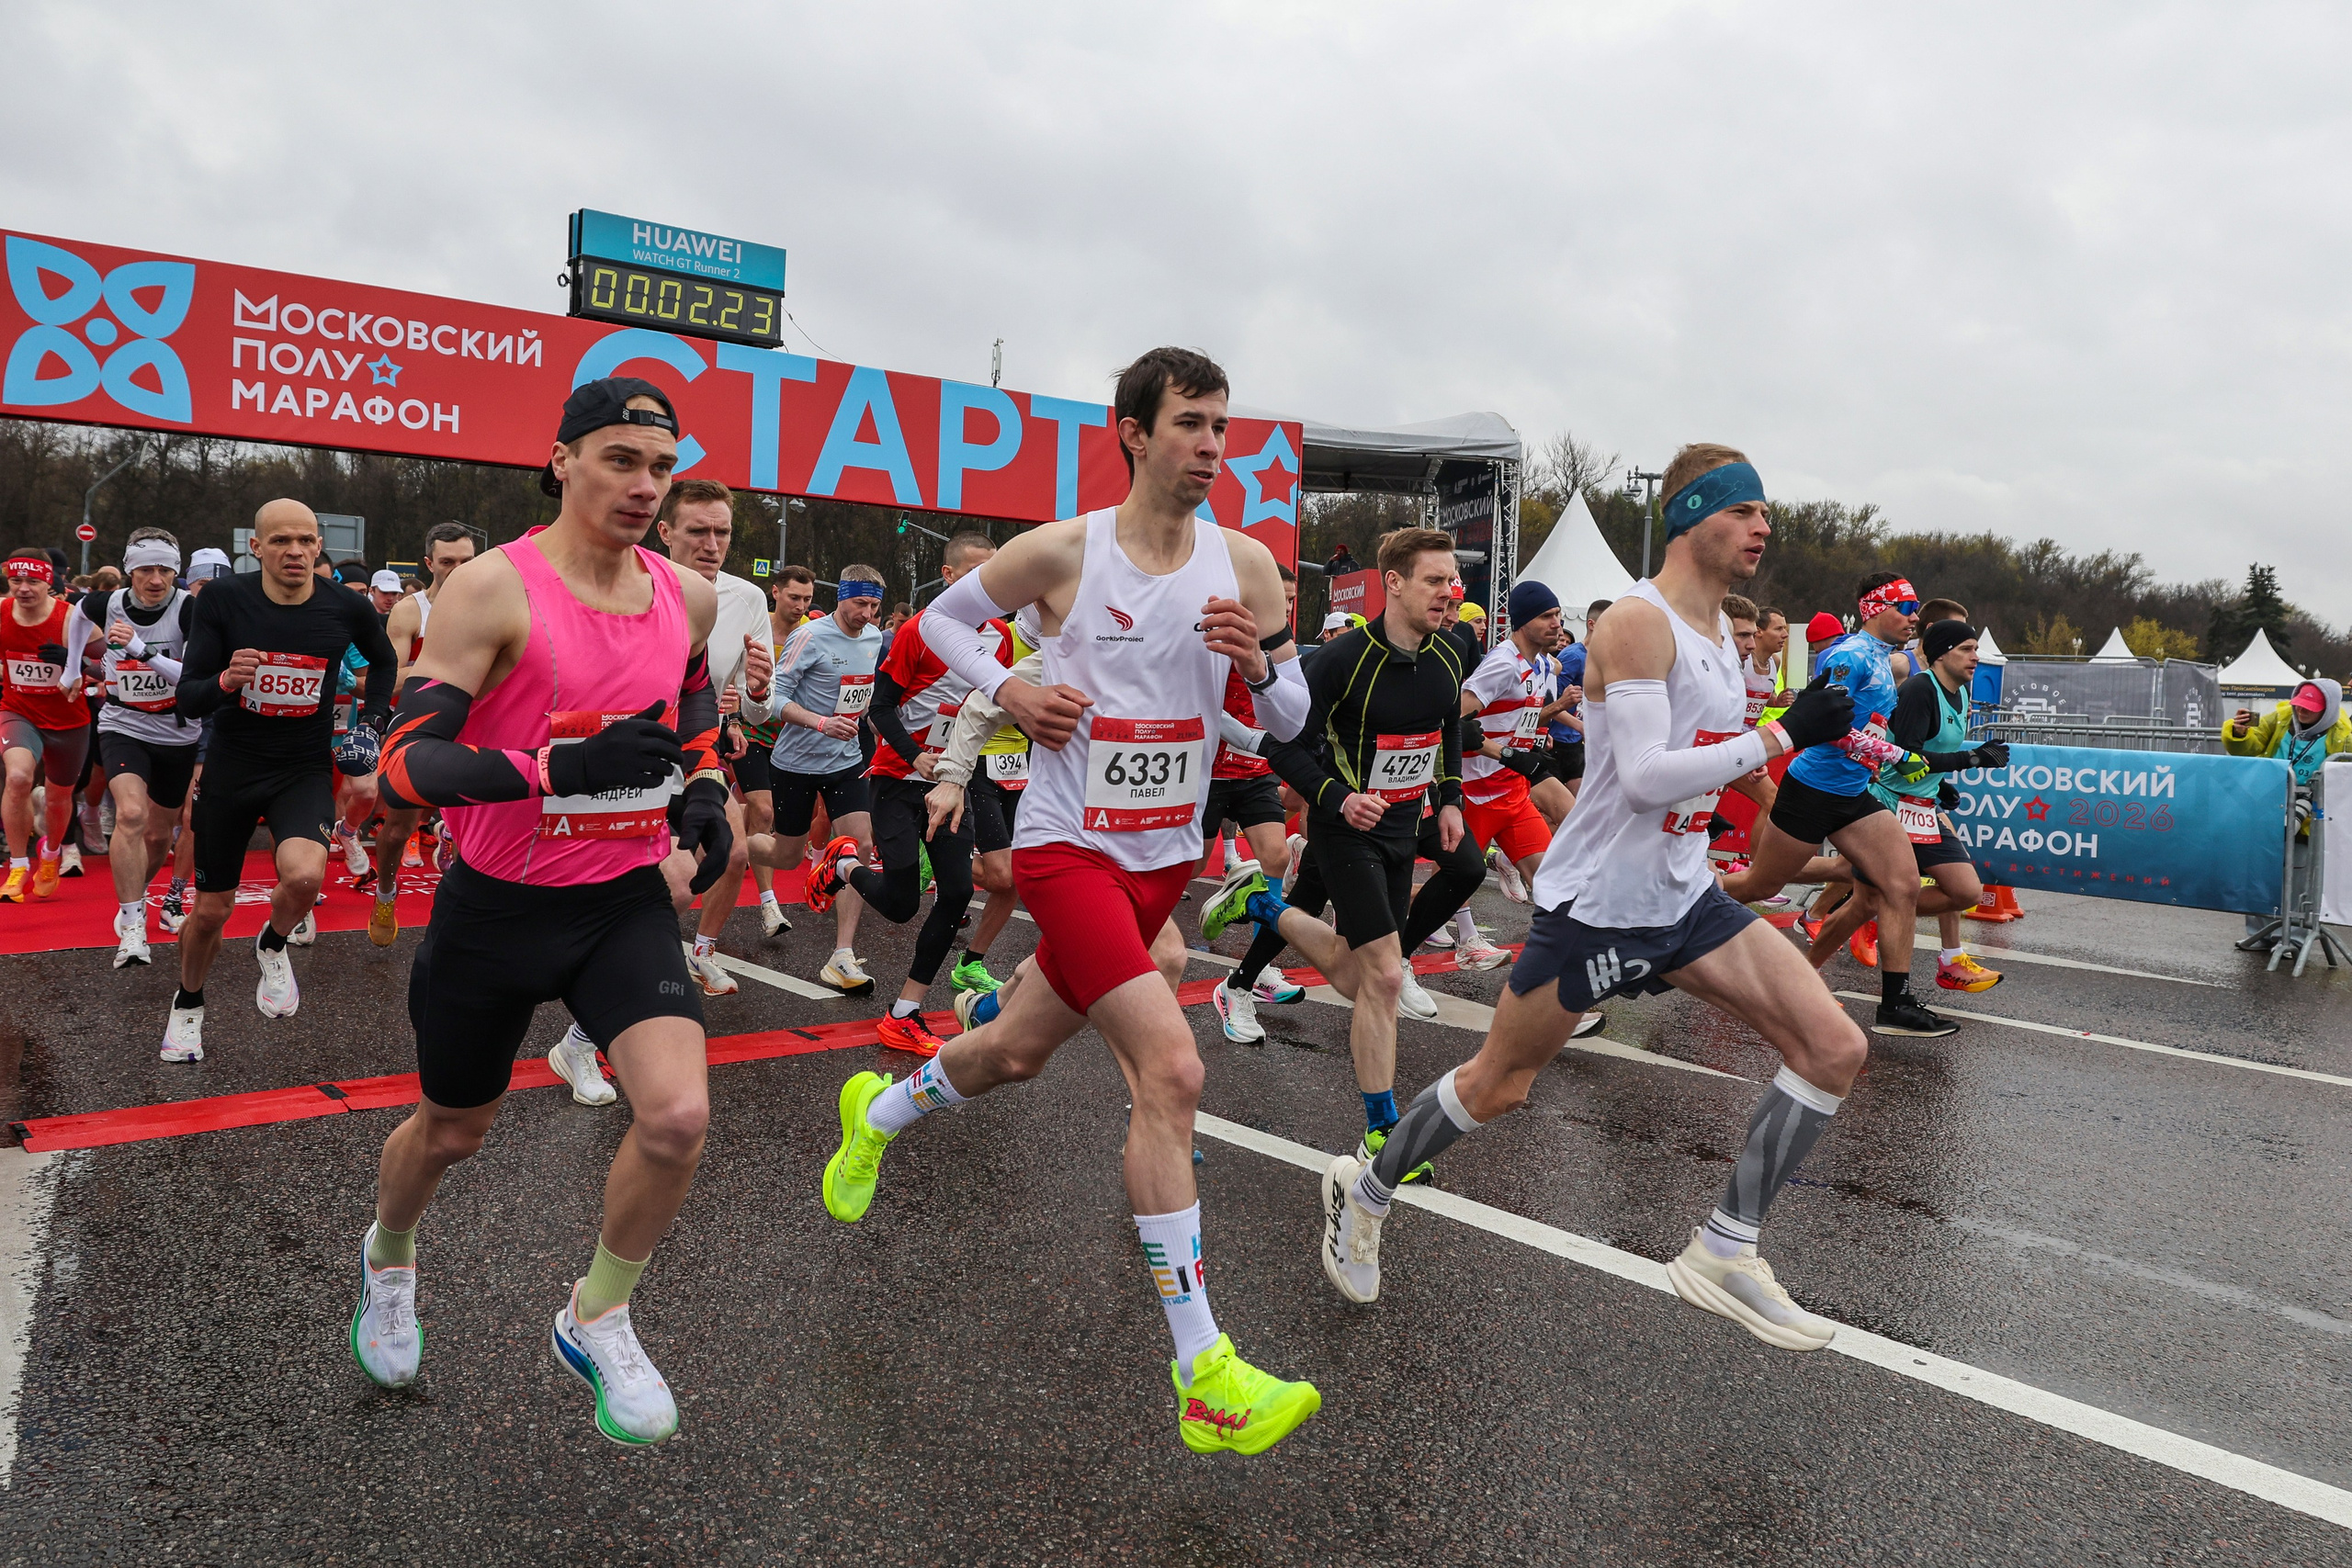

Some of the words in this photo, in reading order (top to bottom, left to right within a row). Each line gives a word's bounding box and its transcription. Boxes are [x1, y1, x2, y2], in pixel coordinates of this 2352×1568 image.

[633, 222, 741, 264] HUAWEI
[632, 249, 674, 266] WATCH
[676, 258, 691, 269] GT
[695, 261, 730, 276] Runner
[733, 268, 741, 278] 2
[233, 288, 543, 367] МОСКОВСКИЙ
[232, 336, 365, 381] ПОЛУ
[232, 378, 459, 434] МАРАФОН
[571, 327, 1108, 523] СТАРТ
[9, 561, 36, 570] VITAL
[1333, 581, 1365, 603] МОСКОВСКИЙ
[16, 663, 53, 679] 4919
[132, 689, 168, 698] АЛЕКСАНДР
[248, 700, 258, 712] A
[1104, 750, 1189, 787] 6331
[1381, 751, 1431, 776] 4729
[2298, 769, 2310, 777] 03
[1130, 787, 1166, 798] ПАВЕЛ
[1093, 809, 1111, 829] A
[1678, 816, 1690, 830] A
[1899, 807, 1936, 829] 17103
[1945, 793, 2021, 819] ОЛУ
[2069, 798, 2174, 832] 2026
[552, 816, 572, 836] A
[1956, 823, 2098, 858] АРАФОН
[2008, 863, 2171, 886] ДОСТИЖЕНИЙ
